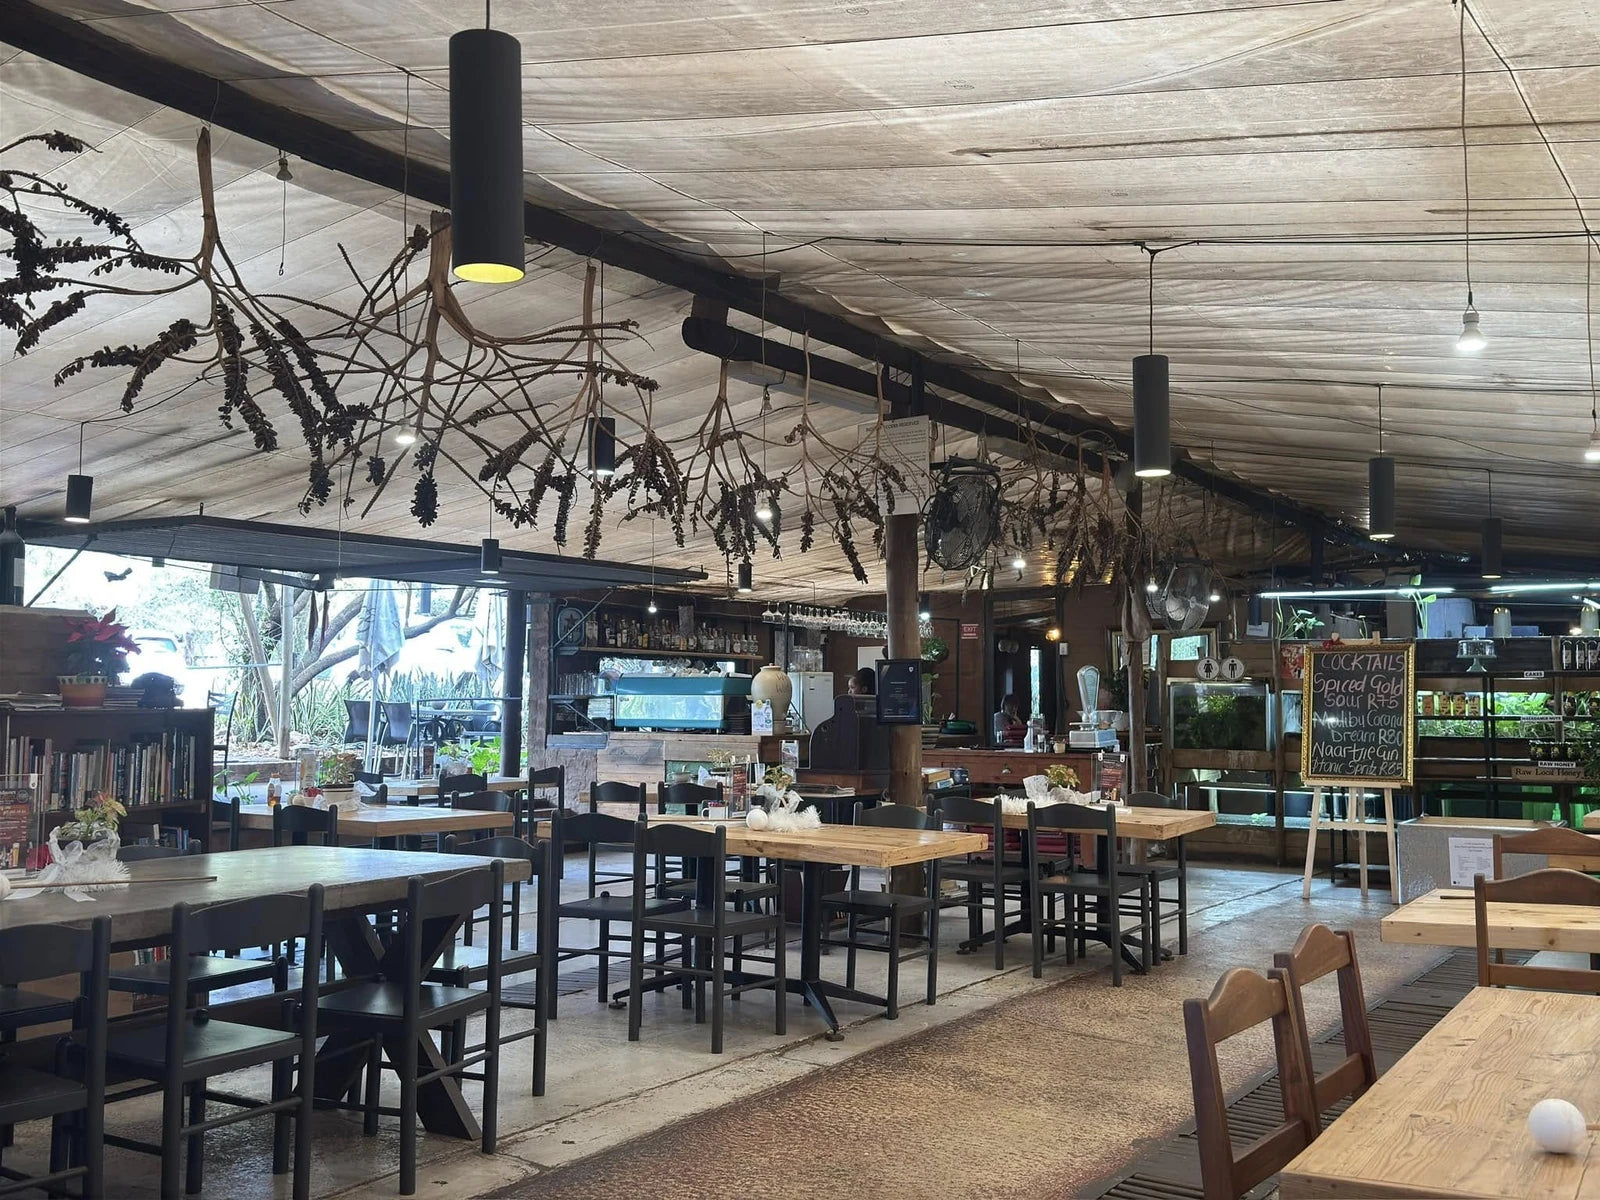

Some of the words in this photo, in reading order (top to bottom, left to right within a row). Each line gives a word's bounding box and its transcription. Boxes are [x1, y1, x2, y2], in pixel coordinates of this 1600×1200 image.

[1321, 653, 1404, 672] COCKTAILS
[1313, 672, 1368, 698] Spiced
[1370, 674, 1403, 696] Gold
[1367, 693, 1398, 710] R75
[1313, 710, 1365, 729] Malibu
[1331, 729, 1375, 742] Dream
[1378, 728, 1403, 746] R80
[1376, 744, 1399, 760] Gin
[1557, 768, 1582, 778] Honey
